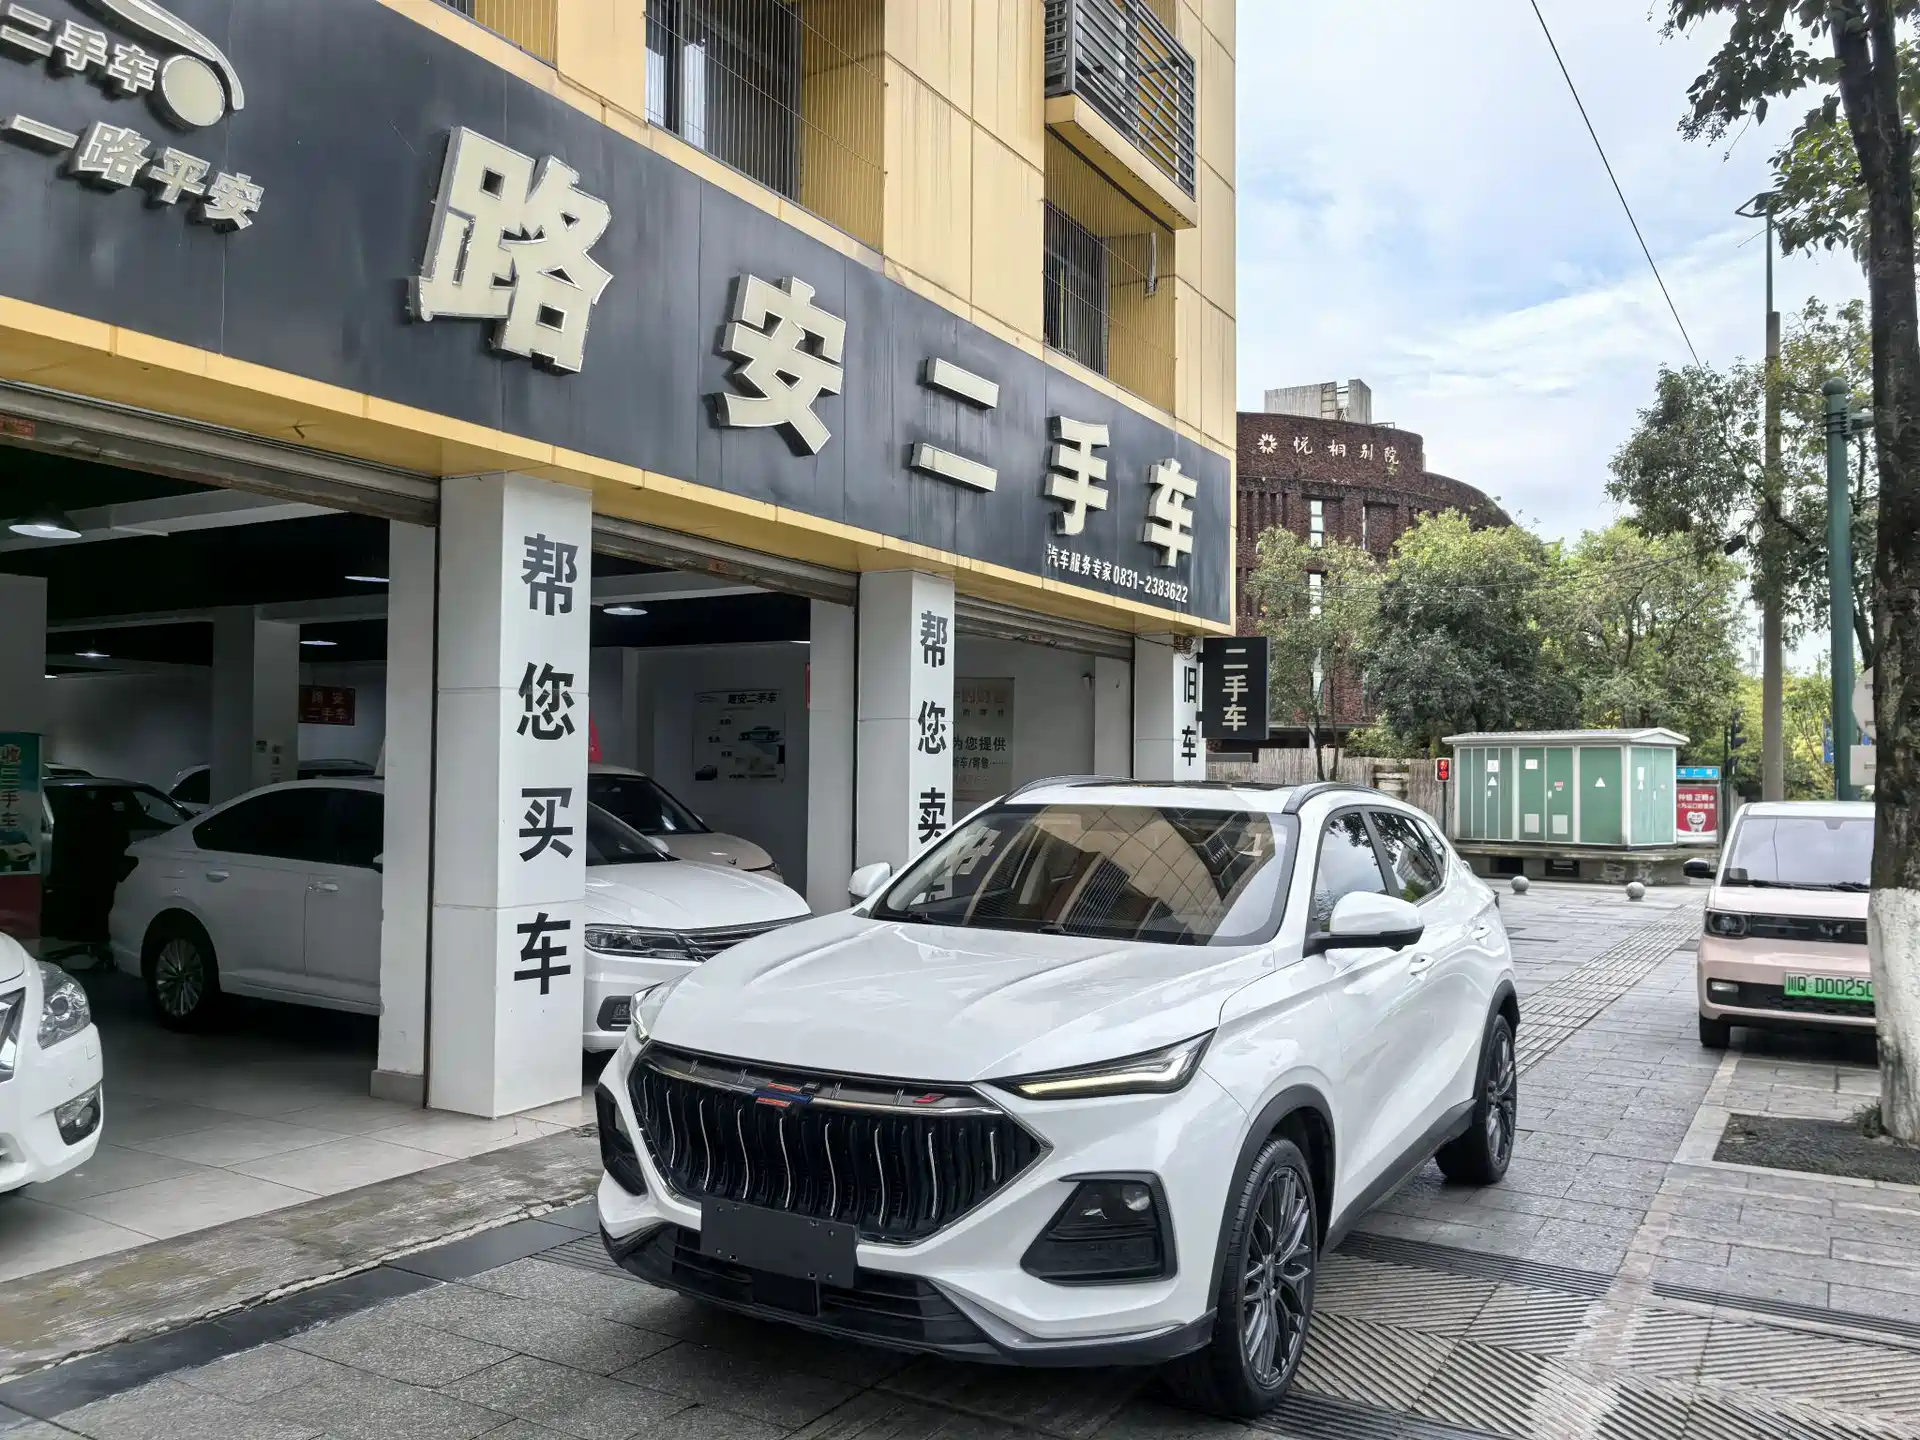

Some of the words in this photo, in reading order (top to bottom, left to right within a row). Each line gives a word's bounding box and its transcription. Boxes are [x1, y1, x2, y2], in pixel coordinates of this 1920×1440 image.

[1, 8, 160, 94] 二手车
[11, 114, 265, 230] 一路平安
[420, 126, 1198, 568] 路安二手车
[515, 532, 579, 995] 帮您买车
[917, 609, 949, 902] 帮您卖
[1221, 648, 1249, 732] 二手车
